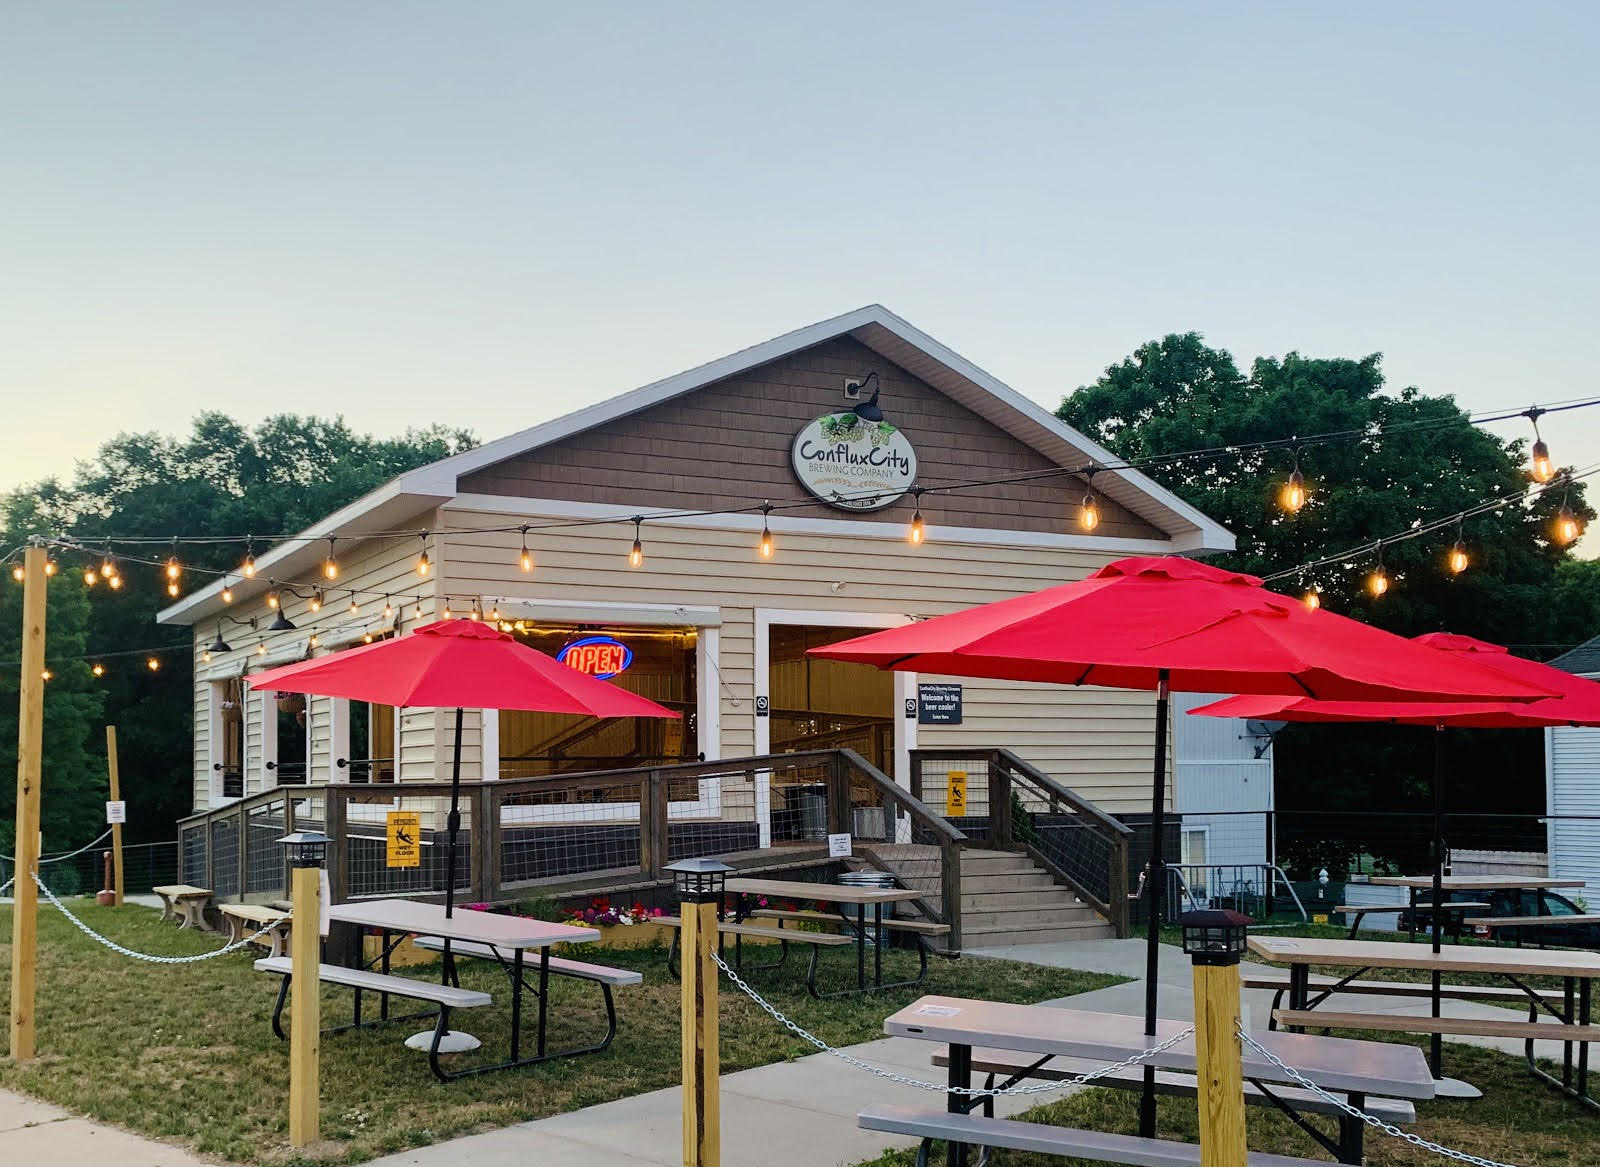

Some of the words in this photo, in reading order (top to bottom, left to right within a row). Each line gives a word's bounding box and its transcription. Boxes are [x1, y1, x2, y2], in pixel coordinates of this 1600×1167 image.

[800, 440, 909, 476] ConfluxCity
[808, 462, 849, 476] BREWING
[850, 465, 895, 479] COMPANY
[566, 646, 624, 674] OPEN
[921, 693, 944, 701] Welcome
[950, 694, 960, 702] the
[925, 702, 937, 711] beer
